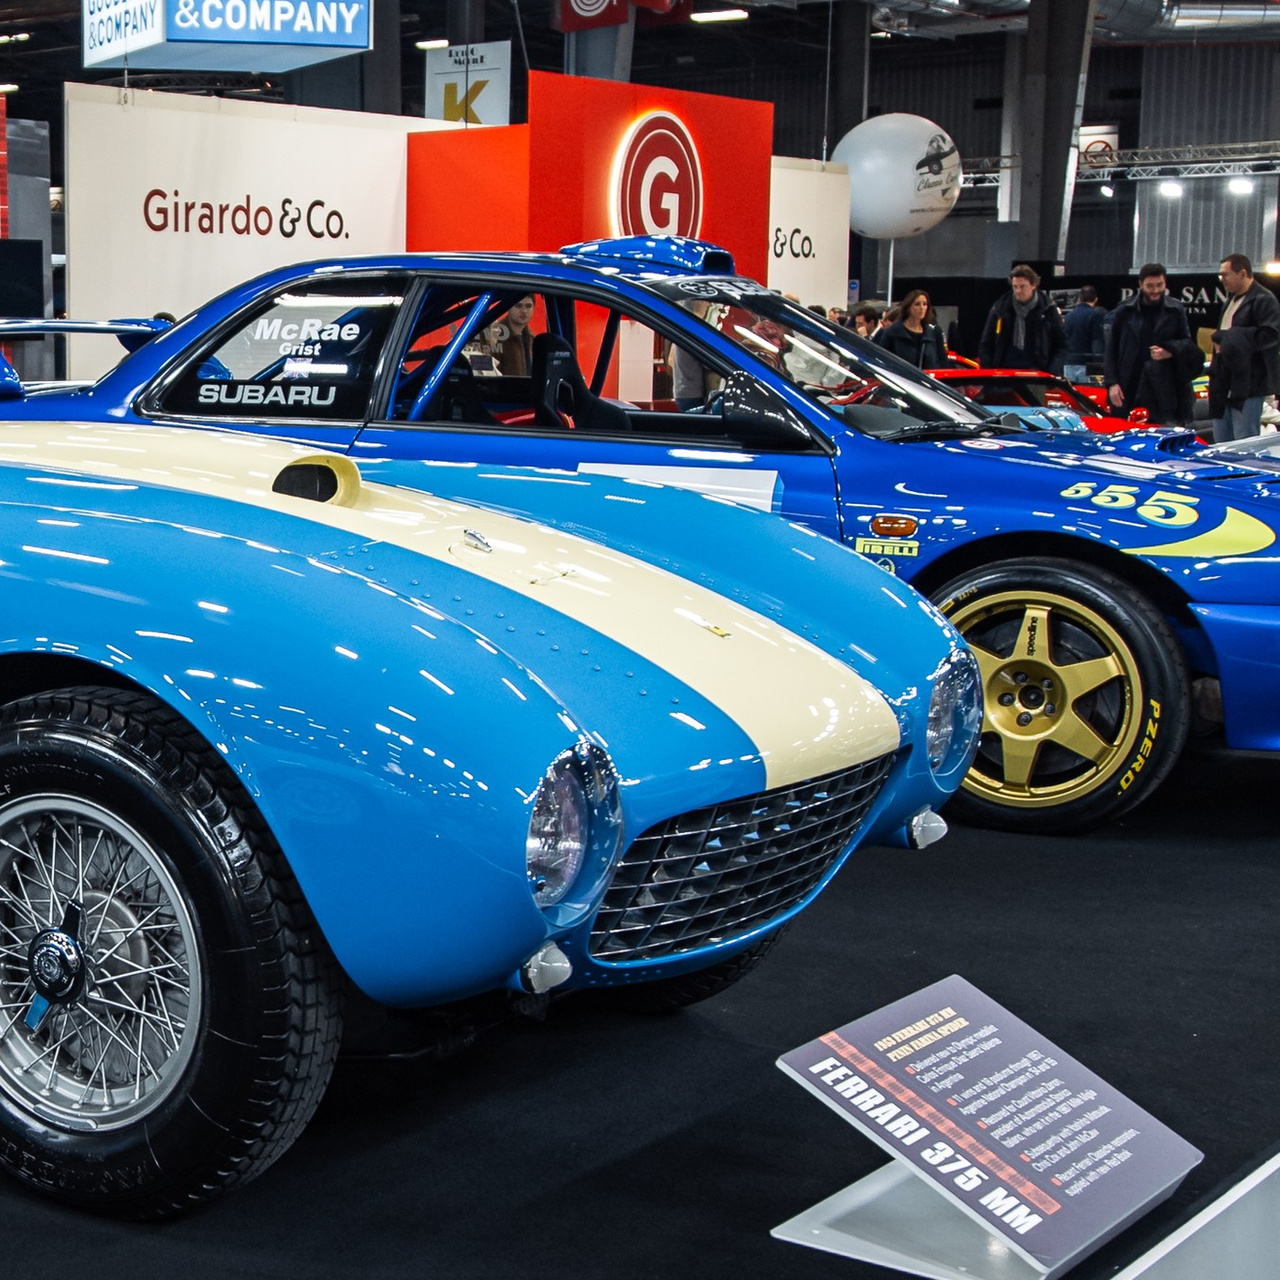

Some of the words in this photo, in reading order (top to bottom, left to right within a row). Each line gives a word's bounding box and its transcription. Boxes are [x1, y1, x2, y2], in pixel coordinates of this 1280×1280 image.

[443, 80, 489, 124] K
[640, 156, 680, 235] G
[254, 318, 361, 341] McRae
[279, 342, 322, 356] Grist
[198, 384, 337, 406] SUBARU
[1059, 481, 1201, 529] 555
[855, 537, 920, 557] PIRELLI
[1026, 616, 1039, 657] speedline
[891, 1020, 930, 1041] FERRARI
[908, 1031, 941, 1049] FARINA
[936, 1017, 969, 1035] SPIDER
[909, 1053, 939, 1071] Delivered
[934, 1048, 952, 1059] new
[951, 1034, 977, 1050] Olympic
[916, 1070, 938, 1083] Carlos
[934, 1072, 965, 1090] Argentina
[958, 1087, 976, 1098] wins
[971, 1081, 987, 1092] and
[988, 1067, 1014, 1082] podiums
[1008, 1057, 1033, 1072] through
[958, 1097, 988, 1116] Argentine
[982, 1086, 1006, 1101] National
[1000, 1073, 1029, 1091] Champion
[1035, 1061, 1050, 1071] and
[982, 1107, 1009, 1125] Restored
[1003, 1102, 1018, 1112] for
[1011, 1095, 1032, 1107] Count
[989, 1120, 1018, 1138] president
[1050, 1088, 1071, 1101] Storico
[1020, 1125, 1036, 1136] who
[1031, 1120, 1045, 1130] ran
[1046, 1109, 1062, 1120] the
[1067, 1096, 1083, 1107] Mille
[1078, 1088, 1099, 1102] Miglia
[808, 1058, 929, 1144] FERRARI
[919, 1142, 989, 1191] 375
[979, 1187, 1042, 1233] MM
[1024, 1133, 1064, 1159] Subsequently
[1056, 1126, 1073, 1138] with
[1031, 1158, 1051, 1171] Chris
[1044, 1151, 1061, 1163] Cox
[1054, 1146, 1070, 1156] and
[1064, 1138, 1082, 1150] John
[1055, 1165, 1079, 1182] Recent
[1072, 1155, 1093, 1170] Ferrari
[1063, 1177, 1091, 1196] supplied
[1084, 1169, 1101, 1181] with
[1095, 1163, 1111, 1174] new
[1104, 1156, 1120, 1167] Red
[1114, 1148, 1131, 1160] Book
